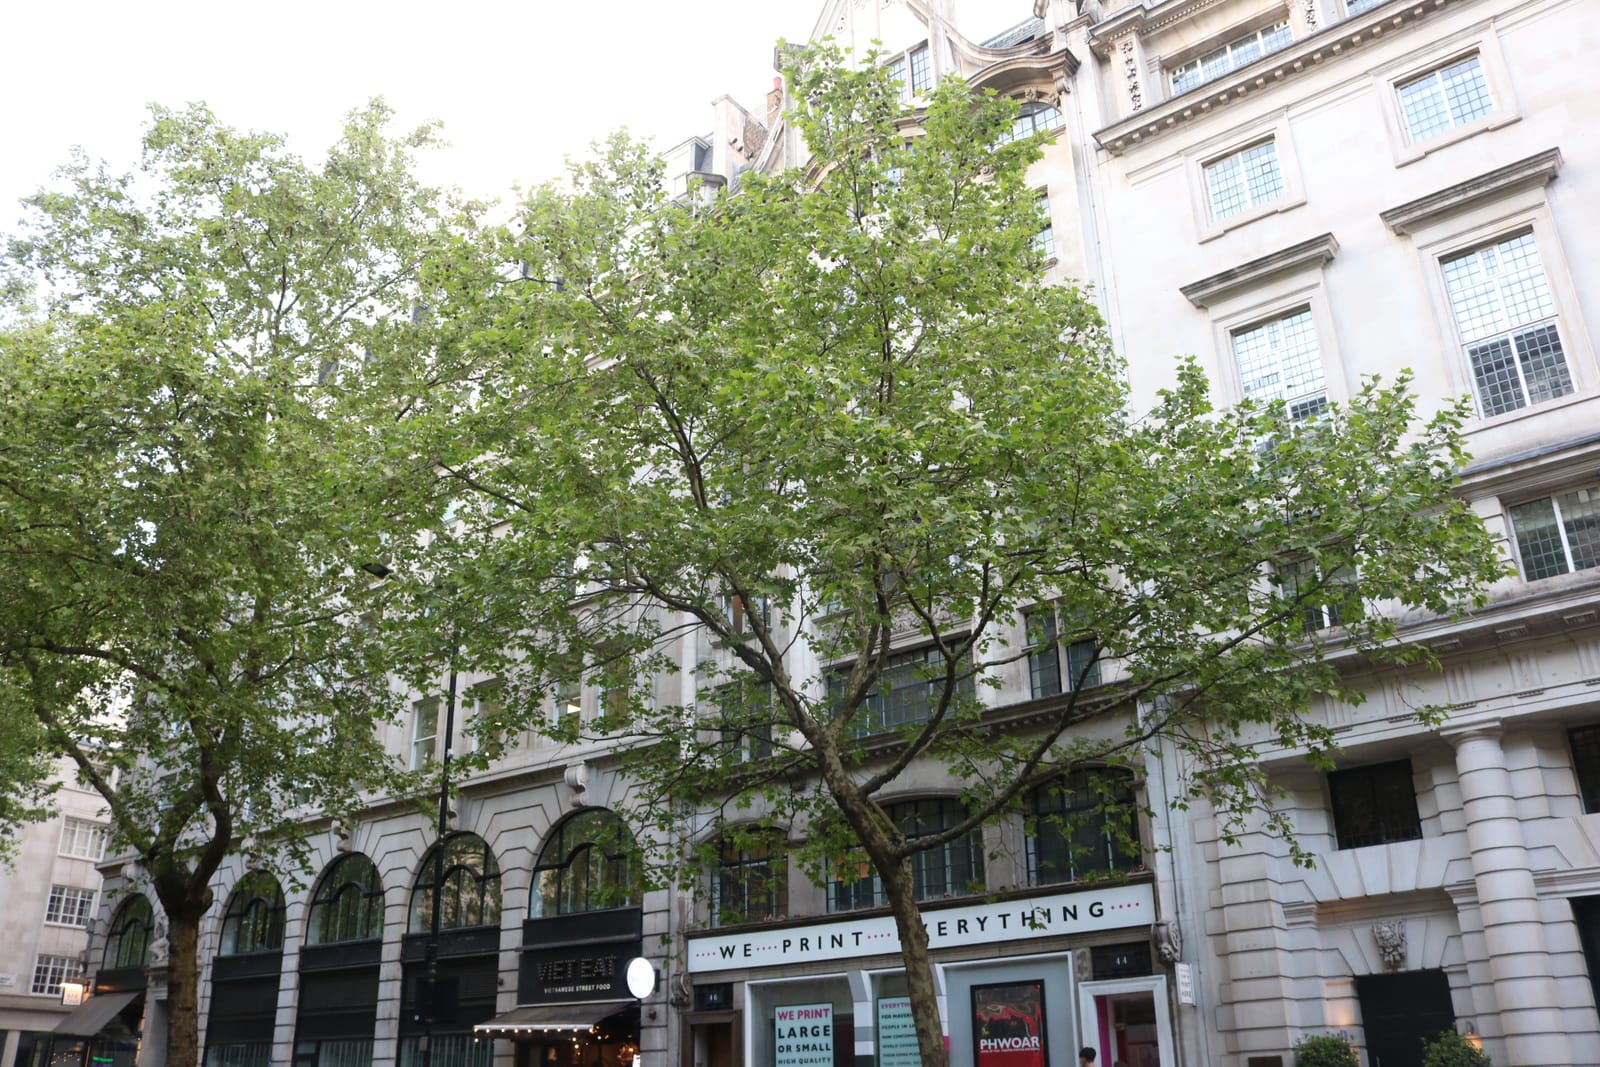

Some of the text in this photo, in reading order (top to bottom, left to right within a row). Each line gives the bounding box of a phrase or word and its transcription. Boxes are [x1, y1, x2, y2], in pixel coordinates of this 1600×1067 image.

[719, 901, 1104, 959] WE PRINT ERYTHING
[536, 955, 617, 981] VIET EAT
[576, 984, 595, 992] STREET
[596, 983, 611, 991] FOOD
[778, 1008, 830, 1021] WE PRINT
[778, 1025, 831, 1039] LARGE
[778, 1043, 831, 1053] OR SMALL
[980, 1036, 1040, 1050] PHWOAR
[799, 1057, 831, 1065] QUALITY
